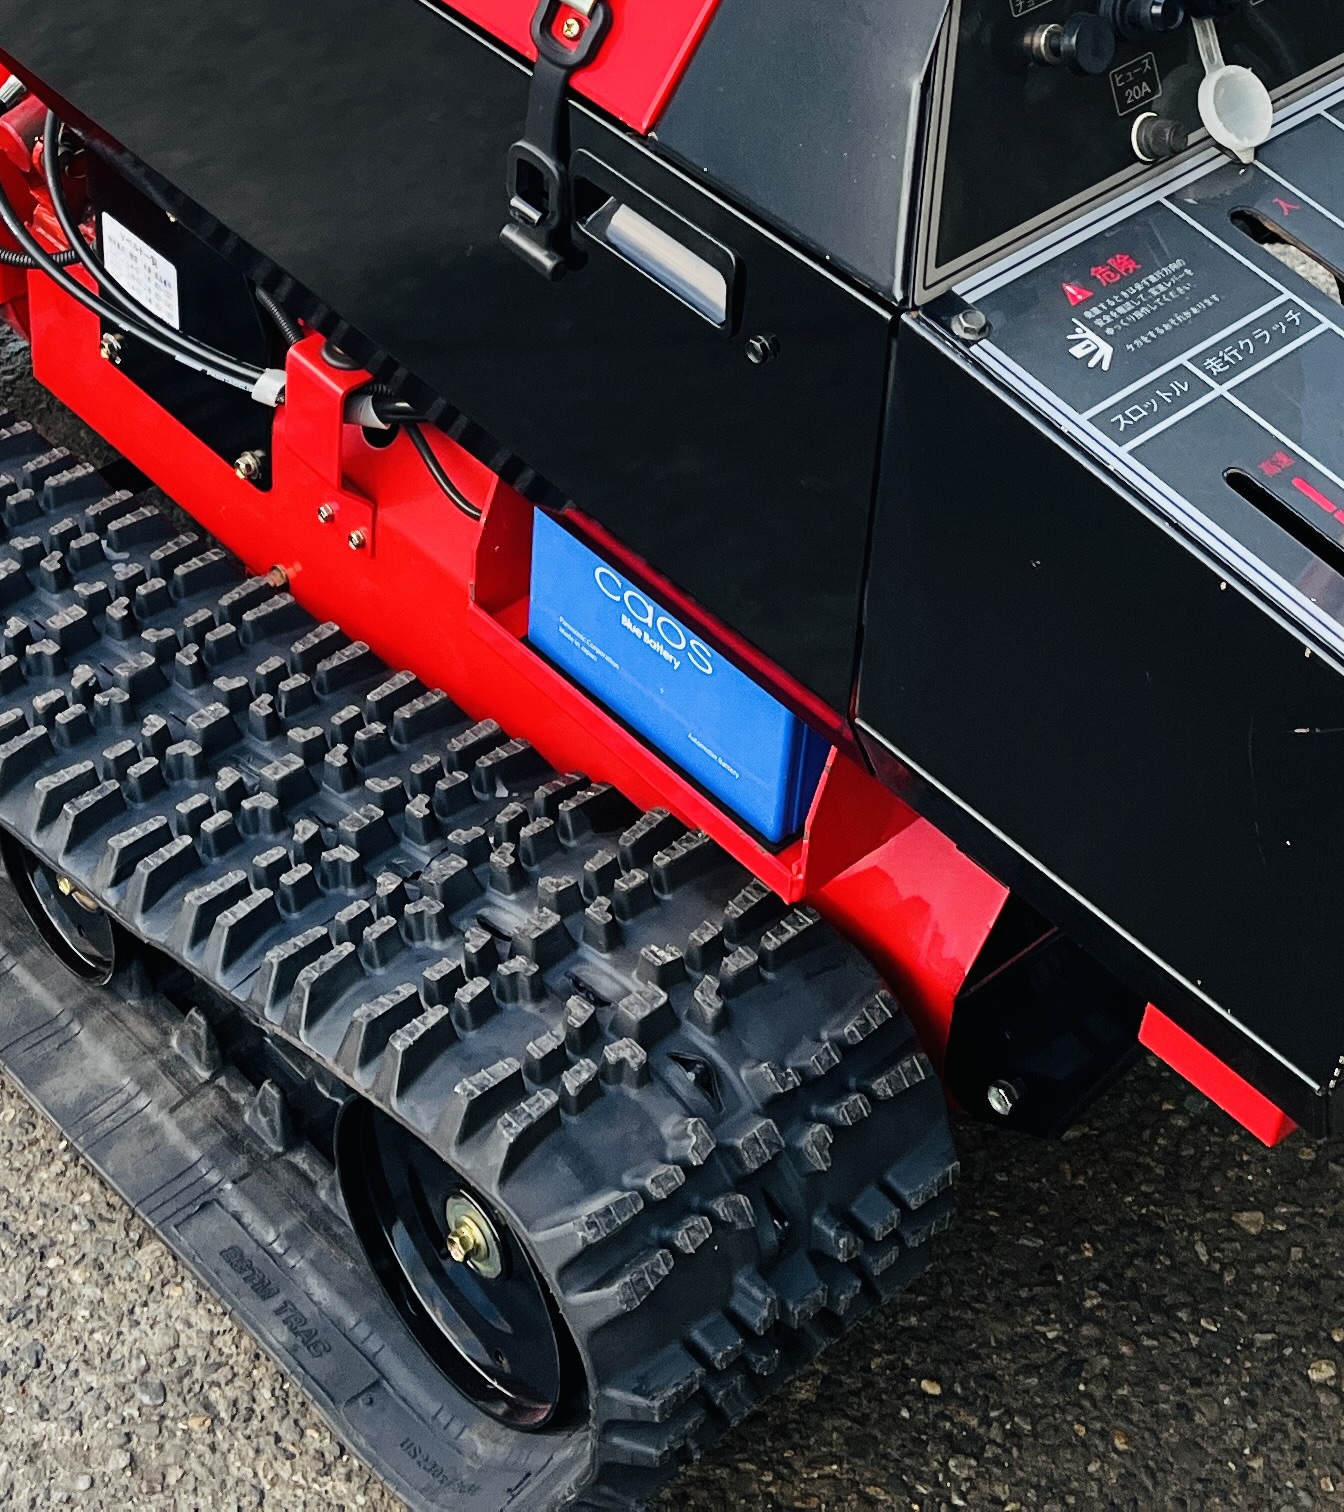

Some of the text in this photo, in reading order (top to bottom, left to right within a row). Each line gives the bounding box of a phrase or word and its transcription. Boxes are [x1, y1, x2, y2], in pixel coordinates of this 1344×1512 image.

[1114, 60, 1154, 87] ヒューズ
[1124, 82, 1152, 105] 20A
[1090, 253, 1142, 287] 危険
[1201, 307, 1304, 376] 走行クラッチ
[1109, 378, 1191, 432] スロットル
[594, 566, 714, 676] caos
[620, 613, 682, 671] Blue Battery
